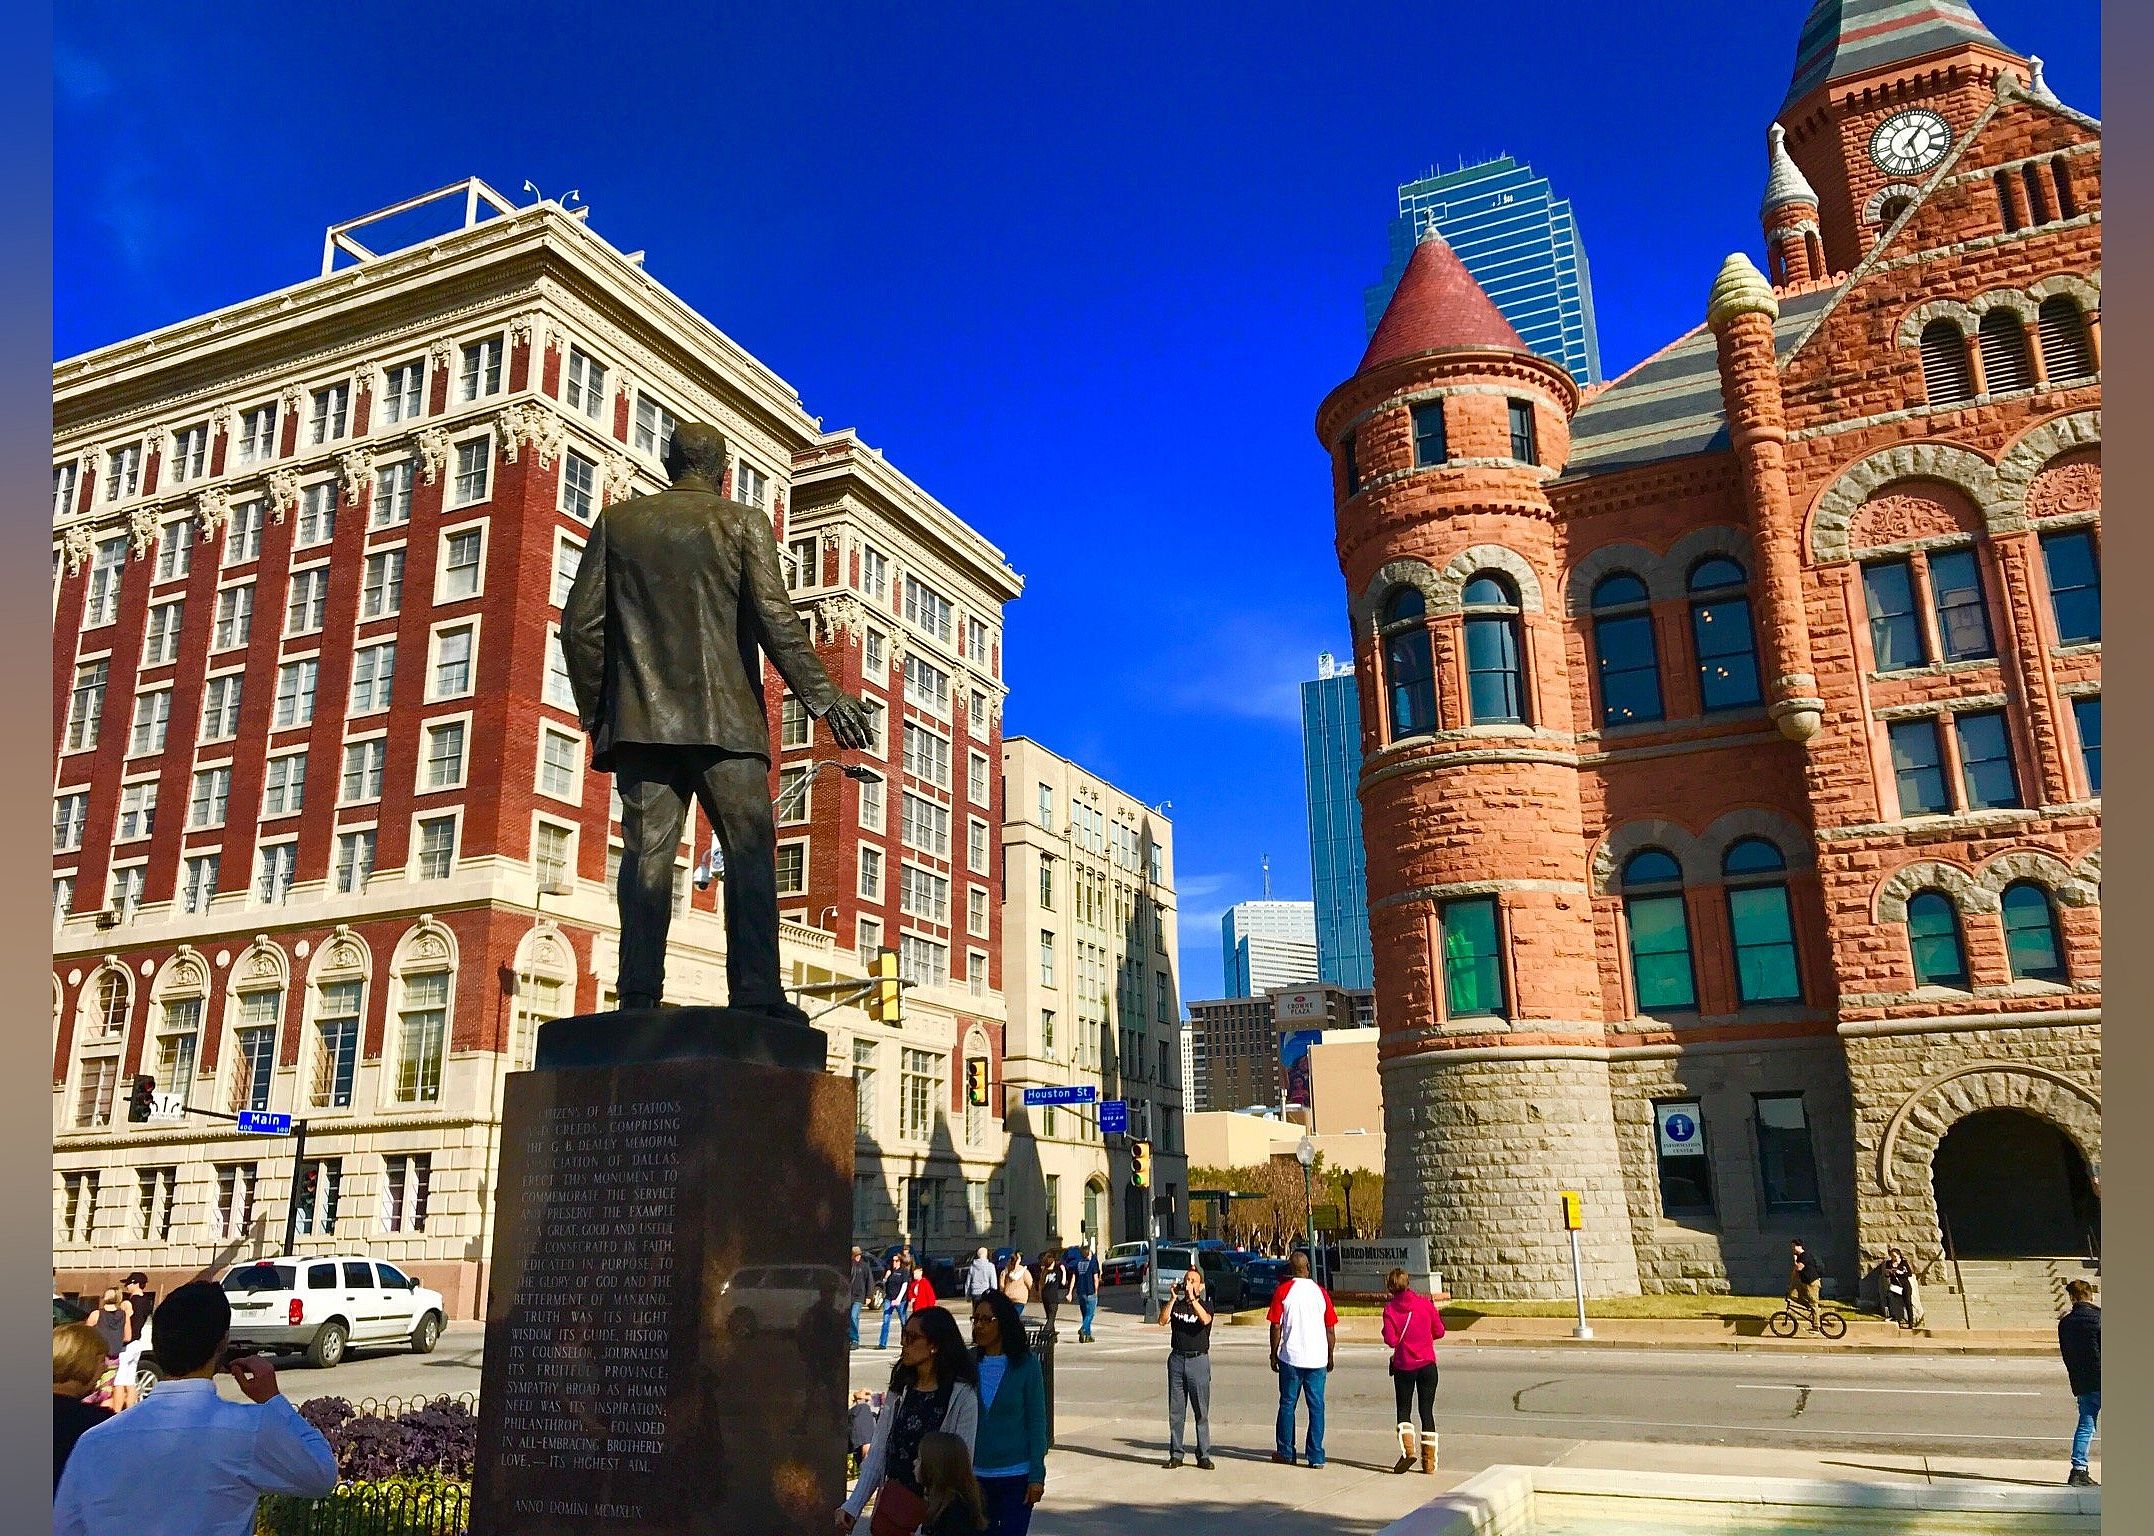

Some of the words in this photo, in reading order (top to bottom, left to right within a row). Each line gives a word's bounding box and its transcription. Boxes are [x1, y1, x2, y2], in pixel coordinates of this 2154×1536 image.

[1028, 1089, 1070, 1099] Houston
[588, 1105, 600, 1117] OF
[607, 1104, 623, 1116] ALL
[632, 1101, 681, 1114] STATIONS
[251, 1113, 280, 1126] Main
[610, 1118, 681, 1133] COMPRISING
[579, 1138, 618, 1151] DEALEY
[625, 1135, 679, 1149] MEMORIAL
[608, 1155, 622, 1167] OF
[564, 1173, 587, 1185] THIS
[594, 1170, 656, 1184] MONUMENT
[664, 1169, 679, 1182] TO
[521, 1189, 599, 1202] COMMEMORATE
[607, 1188, 626, 1200] THE
[634, 1187, 677, 1200] SERVICE
[548, 1206, 595, 1220] PRESERVE
[603, 1206, 621, 1218] THE
[629, 1204, 676, 1218] EXAMPLE
[582, 1224, 609, 1237] GOOD
[614, 1223, 635, 1235] AND
[545, 1240, 618, 1253] CONSECRATED
[624, 1240, 636, 1253] IN
[1364, 1246, 1408, 1260] MUSEUM
[582, 1258, 594, 1270] IN
[659, 1257, 674, 1269] TO
[539, 1275, 571, 1288] GLORY
[576, 1275, 590, 1288] OF
[596, 1275, 618, 1288] GOD
[623, 1275, 646, 1288] AND
[652, 1275, 674, 1288] THE
[513, 1293, 583, 1306] BETTERMENT
[590, 1293, 604, 1305] OF
[524, 1311, 561, 1323] TRUTH
[571, 1311, 594, 1323] WAS
[603, 1311, 622, 1323] ITS
[511, 1328, 551, 1341] WISDOM
[559, 1328, 575, 1341] ITS
[625, 1329, 670, 1342] HISTORY
[509, 1345, 524, 1358] ITS
[602, 1347, 669, 1360] JOURNALISM
[508, 1363, 525, 1376] ITS
[537, 1363, 592, 1377] FRUITFUL
[506, 1381, 559, 1395] SYMPATHY
[566, 1382, 600, 1395] BROAD
[607, 1384, 620, 1396] AS
[627, 1384, 667, 1397] HUMAN
[505, 1399, 533, 1412] NEED
[540, 1400, 562, 1413] WAS
[569, 1401, 586, 1414] ITS
[611, 1421, 666, 1435] FOUNDED
[501, 1435, 513, 1448] IN
[519, 1436, 601, 1451] ALL-EMBRACING
[607, 1439, 664, 1454] BROTHERLY
[573, 1456, 620, 1471] HIGHEST
[515, 1500, 544, 1513] ANNO
[550, 1502, 589, 1516] DOMINI
